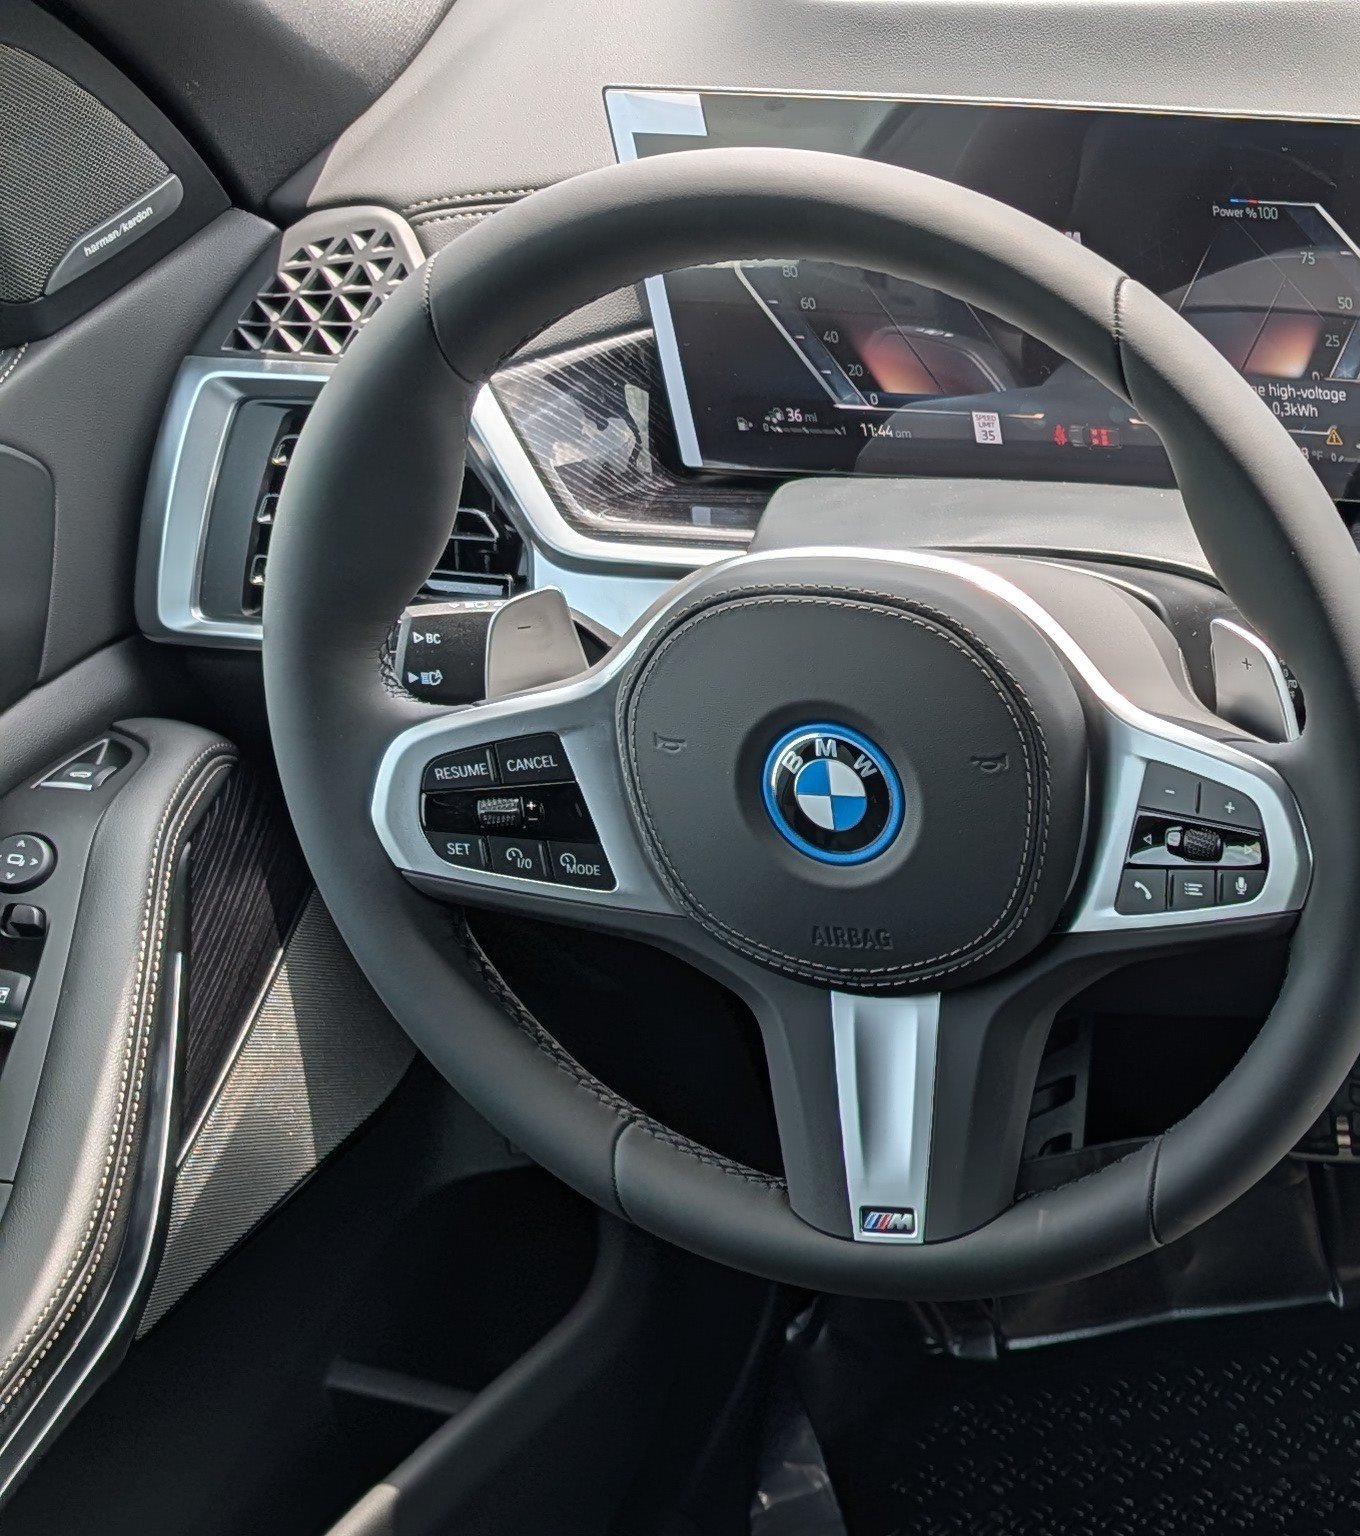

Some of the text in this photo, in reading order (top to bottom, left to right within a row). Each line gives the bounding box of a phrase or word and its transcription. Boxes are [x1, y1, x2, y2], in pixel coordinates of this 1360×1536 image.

[1212, 204, 1244, 218] Power
[1257, 206, 1279, 220] 100
[83, 206, 154, 257] harman/kardon
[1300, 251, 1316, 266] 75
[782, 264, 799, 279] 80
[800, 297, 817, 311] 60
[1337, 296, 1353, 311] 50
[823, 331, 839, 344] 40
[1325, 334, 1341, 348] 25
[847, 363, 864, 378] 20
[869, 392, 879, 406] 0
[1268, 383, 1347, 403] high-voltage
[785, 407, 818, 423] 36 mi
[1272, 401, 1319, 418] 0,3kWh
[974, 413, 997, 422] SPEED
[977, 421, 996, 429] LIMIT
[859, 422, 912, 439] 11:44 am
[980, 429, 996, 442] 35
[425, 632, 442, 645] BC
[506, 754, 558, 772] CANCEL
[782, 738, 878, 779] BMW
[434, 762, 490, 781] RESUME
[446, 842, 471, 856] SET
[565, 863, 601, 876] MODE
[810, 924, 894, 950] AIRBAG
